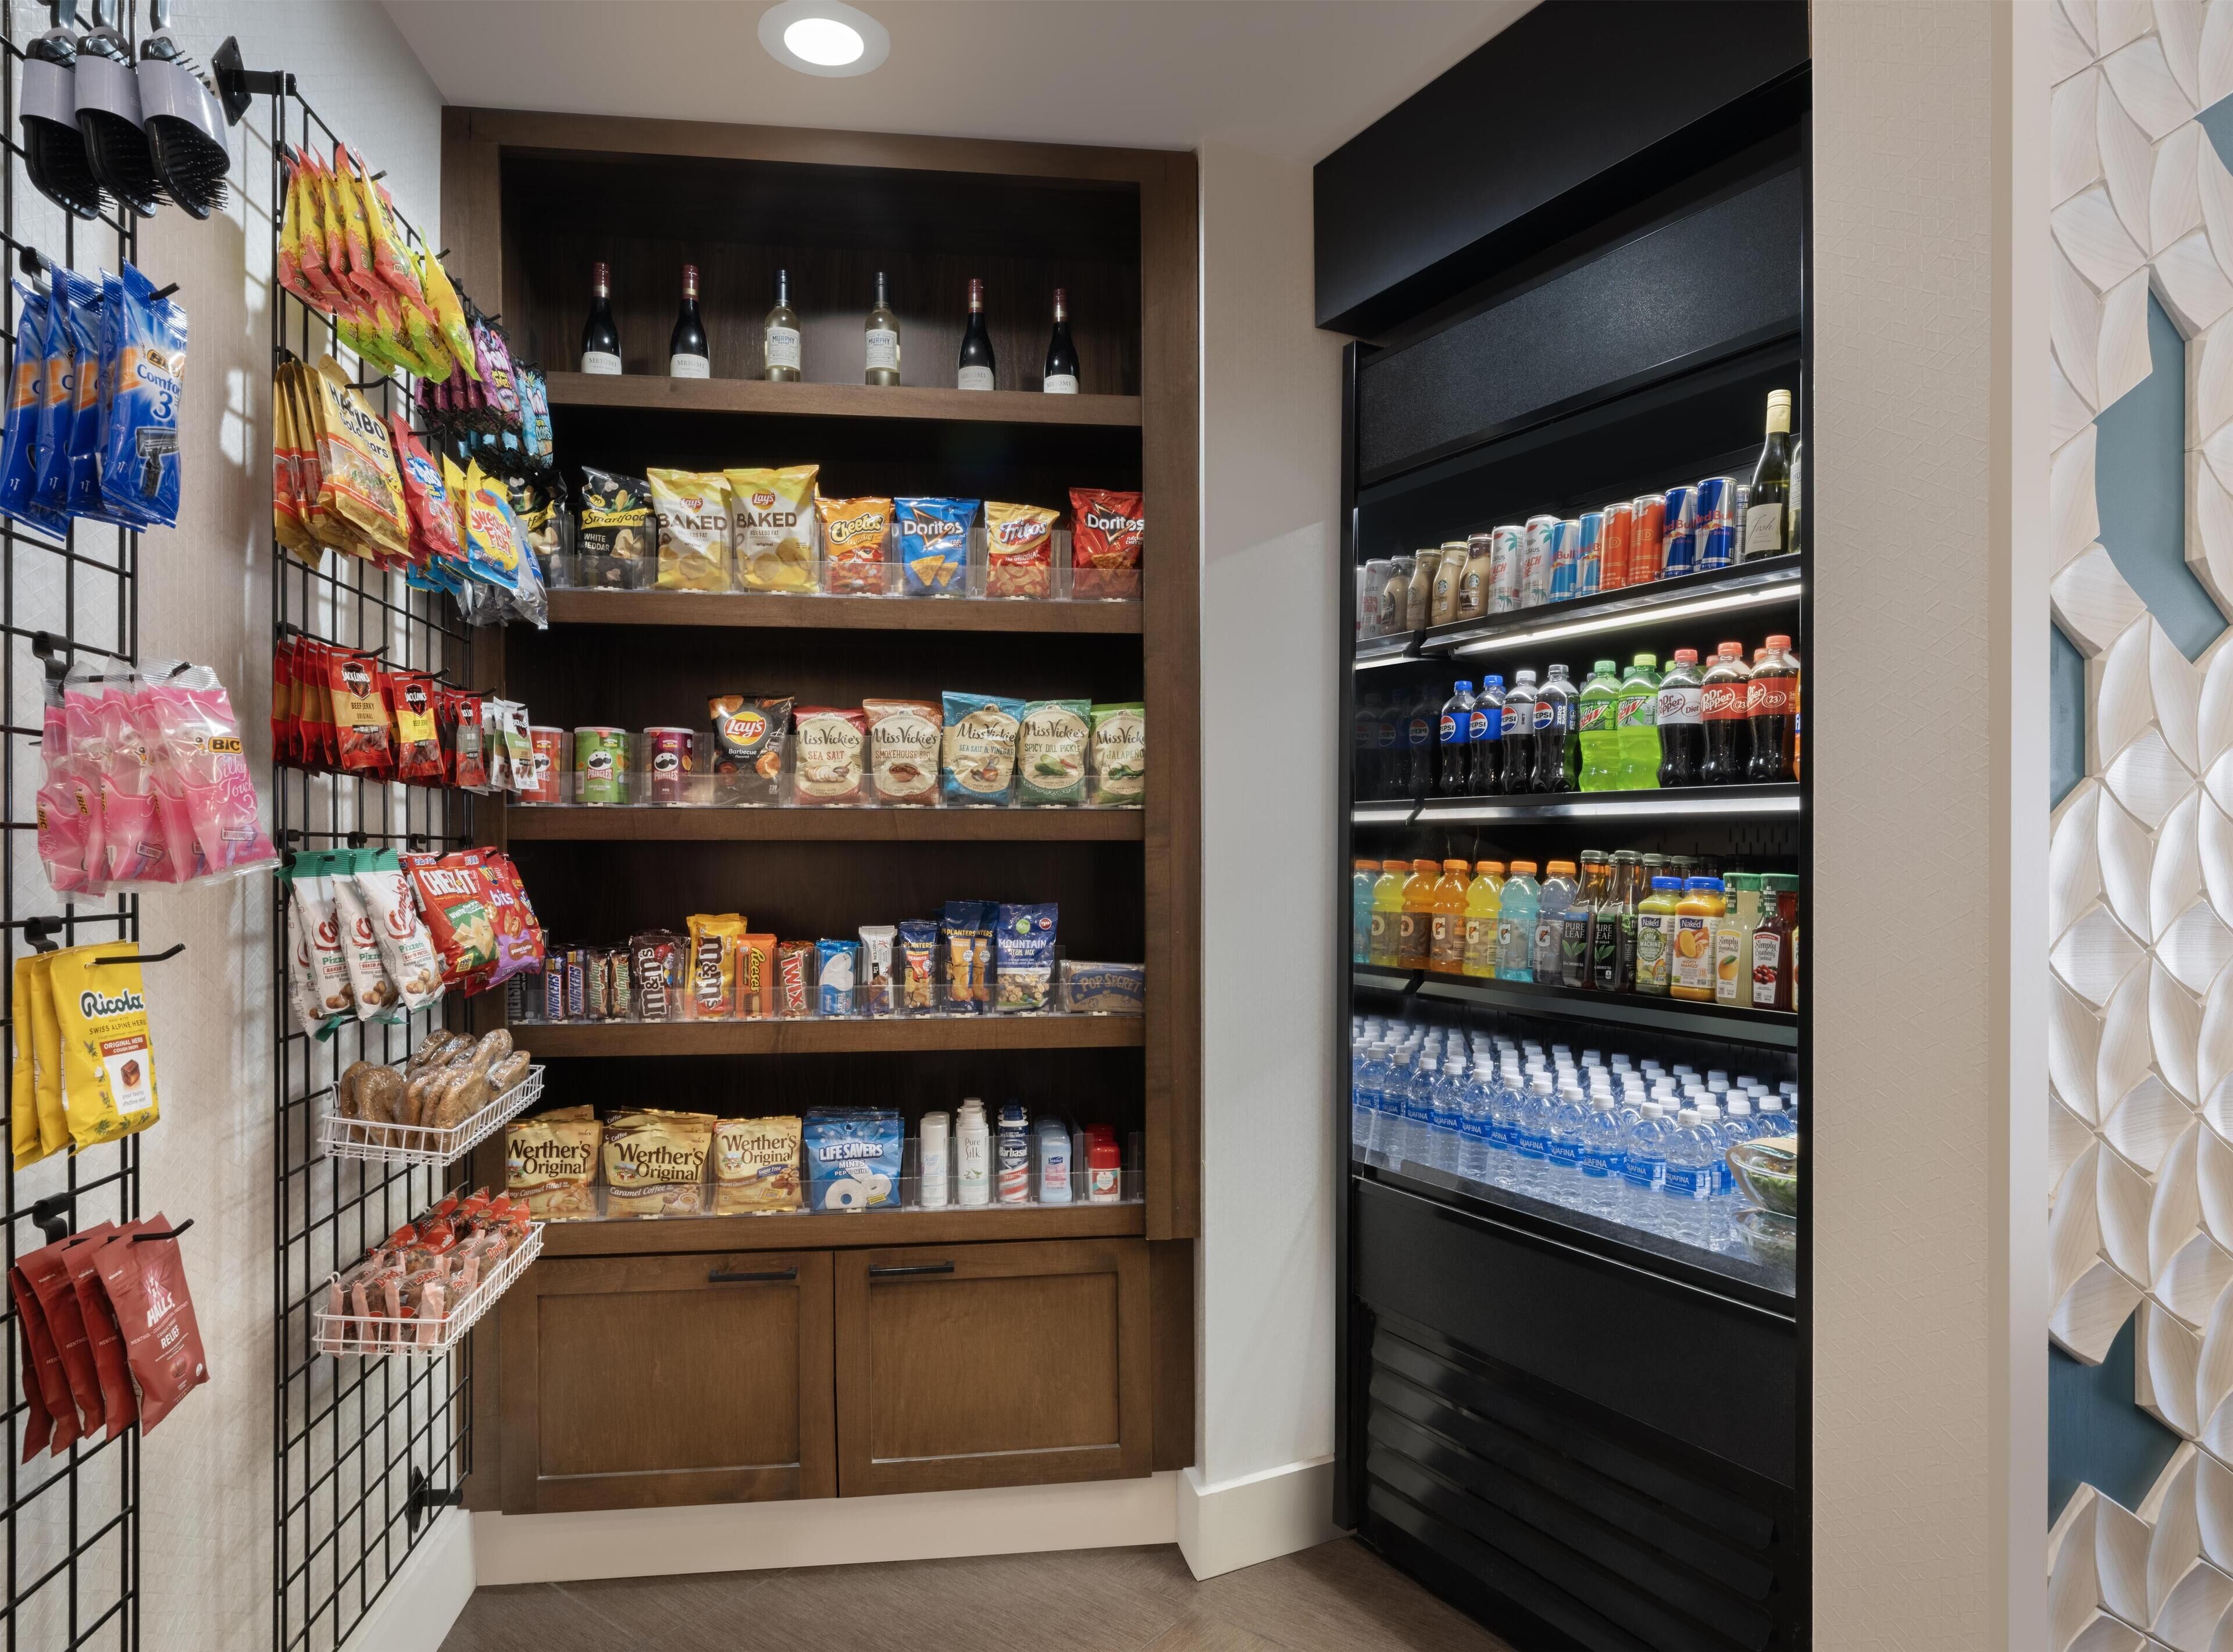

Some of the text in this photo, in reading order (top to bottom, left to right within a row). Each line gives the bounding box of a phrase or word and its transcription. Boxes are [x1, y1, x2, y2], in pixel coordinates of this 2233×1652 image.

[772, 336, 794, 344] MURPHY
[869, 337, 890, 346] MURPHY
[153, 390, 173, 419] 3
[754, 493, 775, 505] Lay's
[658, 513, 726, 530] BAKED
[737, 512, 797, 528] BAKED
[1088, 513, 1144, 530] Doritos
[1714, 511, 1733, 520] Bull
[830, 513, 883, 543] Cheetos
[904, 521, 964, 535] Doritos
[1000, 520, 1047, 543] Fritos
[1747, 514, 1776, 542] Josh
[584, 533, 606, 542] WHITE
[342, 670, 354, 682] JACK
[405, 692, 414, 702] JACK
[1663, 695, 1674, 704] Dr
[1702, 693, 1732, 711] Pepper
[1768, 695, 1779, 703] 23
[1686, 706, 1699, 714] Diet
[727, 720, 766, 737] Lay's
[820, 725, 861, 748] Vickie's
[958, 723, 983, 739] Miss
[1024, 719, 1085, 742] Miss Vickie's
[872, 725, 937, 749] Miss Vickie's
[1096, 730, 1122, 746] Miss
[808, 751, 844, 760] SEA SALT
[875, 750, 930, 760] SMOKEHOUSE BBQ
[990, 747, 1014, 755] VINEGAR
[1025, 743, 1080, 752] SPICY DILL PICKLE
[215, 756, 247, 783] Silky
[588, 769, 612, 779] PRINGLES
[654, 770, 678, 780] PRINGLES
[219, 777, 255, 803] Touch
[489, 890, 514, 907] bits
[1432, 917, 1446, 940] G
[1467, 921, 1480, 944] G
[1499, 923, 1511, 945] G
[1565, 922, 1585, 930] PURE
[998, 940, 1047, 948] MOUNTAIN
[1535, 925, 1551, 947] G
[1718, 937, 1738, 949] Simply
[511, 947, 522, 955] peanut
[1756, 940, 1776, 951] Simply
[1755, 950, 1775, 959] Cranberry
[698, 935, 724, 1010] m&m's
[782, 952, 802, 1008] TWIX
[569, 966, 582, 1014] SNICKERS
[590, 963, 605, 1008] Milky Way
[615, 964, 630, 1008] Milky Way
[640, 948, 667, 1016] m&m's
[81, 990, 144, 1018] Ricola
[548, 975, 560, 1019] SNICKERS
[90, 1026, 109, 1034] SWISS
[112, 1022, 131, 1030] ALPINE
[104, 1039, 131, 1050] ORIGINAL
[607, 1114, 622, 1124] Coffee
[611, 1132, 627, 1141] Coffee
[722, 1133, 797, 1152] Werther's
[965, 1137, 980, 1147] Pure
[509, 1140, 591, 1158] Werther's
[614, 1143, 704, 1166] Werther's
[741, 1148, 793, 1166] Original
[820, 1143, 883, 1161] LIFE SAVERS
[965, 1146, 982, 1161] Silk
[1000, 1147, 1027, 1158] Barbasol
[523, 1158, 587, 1178] Original
[636, 1162, 698, 1182] Original
[839, 1159, 865, 1169] MINTS
[520, 1182, 562, 1196] Caramel Filled
[611, 1185, 665, 1197] Caramel Coffee
[486, 1236, 508, 1261] David's
[131, 1332, 151, 1346] MENTHOL
[160, 1325, 180, 1350] RELIEF
